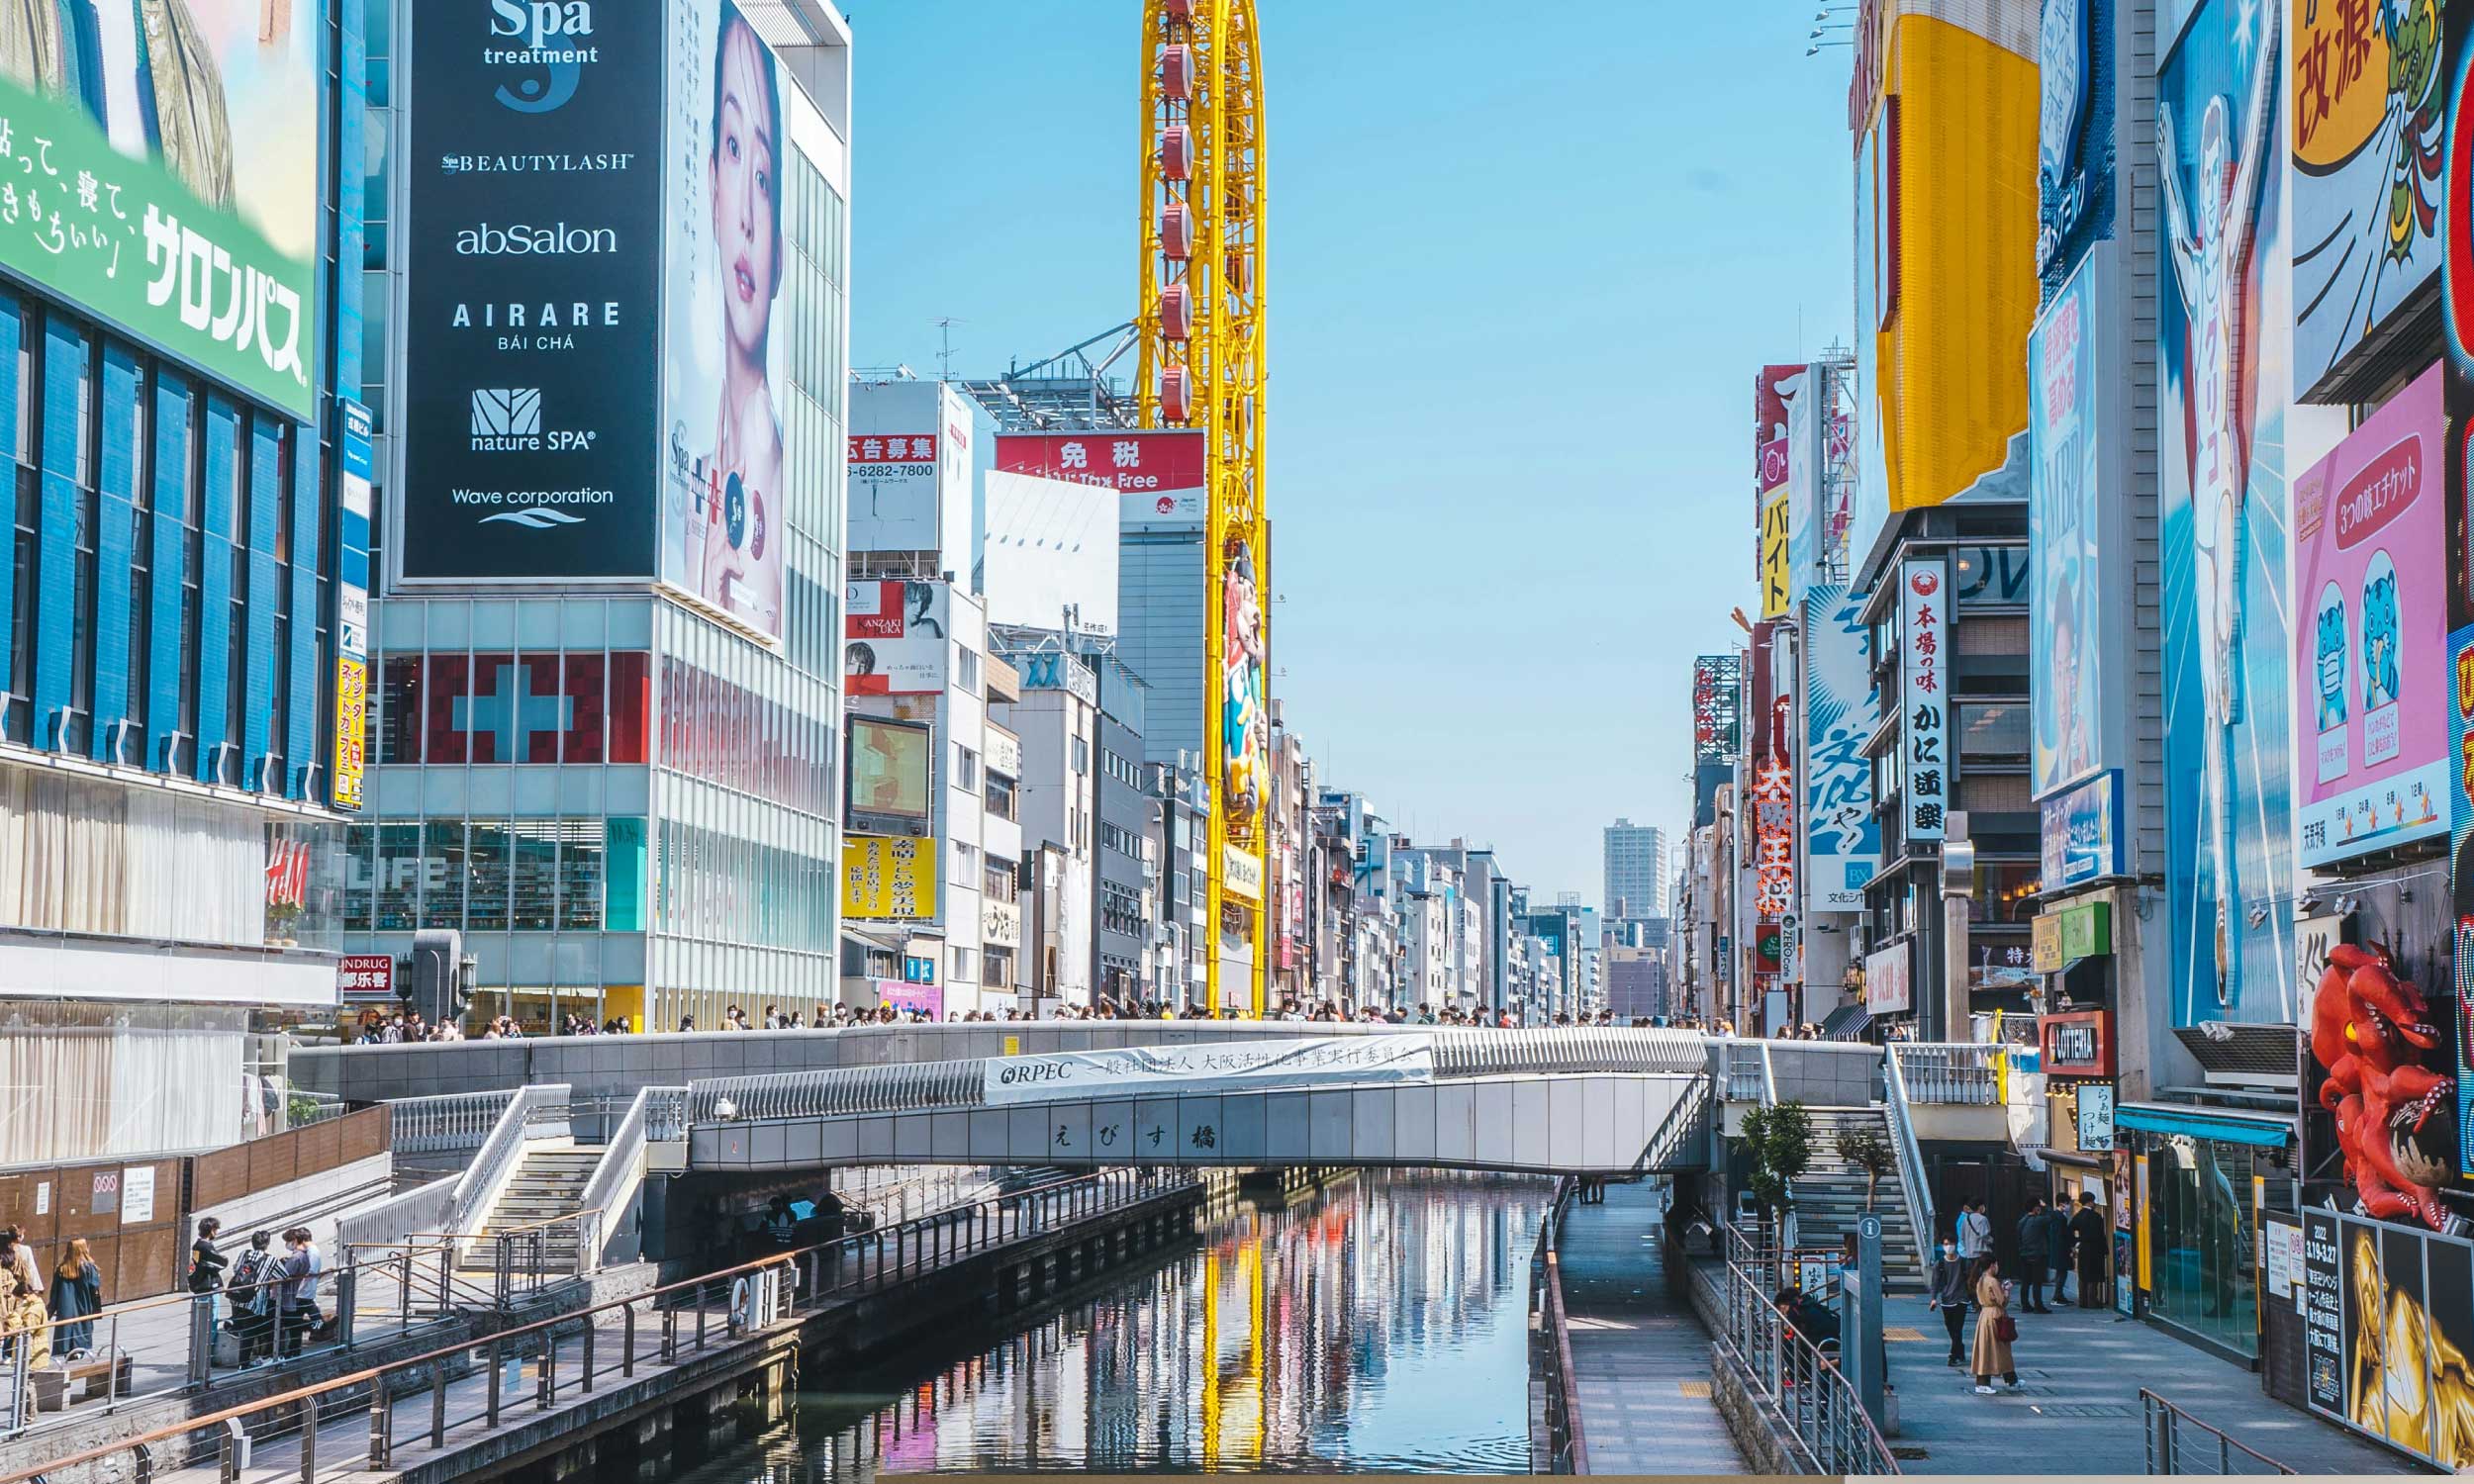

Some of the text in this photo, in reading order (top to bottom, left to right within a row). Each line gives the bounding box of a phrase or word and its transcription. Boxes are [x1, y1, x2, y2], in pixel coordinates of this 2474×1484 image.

[491, 0, 594, 47] Spa
[483, 47, 599, 64] treatment
[455, 221, 618, 254] abSalon
[143, 203, 303, 385] サロンパス
[452, 302, 618, 326] AIRARE
[498, 333, 574, 350] BÁI CHÁ
[471, 434, 540, 451] nature
[1061, 441, 1140, 469] 免税
[1118, 473, 1158, 489] Free
[452, 487, 614, 507] Wave corporation
[1914, 603, 1938, 695] 本場の味
[1913, 703, 1943, 831] かに道楽
[1753, 762, 1792, 912] 大阪王将
[1849, 869, 1868, 882] BX
[2057, 1028, 2093, 1059] LOTTERIA
[1055, 1124, 1216, 1149] えびす橋
[2082, 1111, 2096, 1148] つけ麺
[2314, 1225, 2327, 1241] 2022
